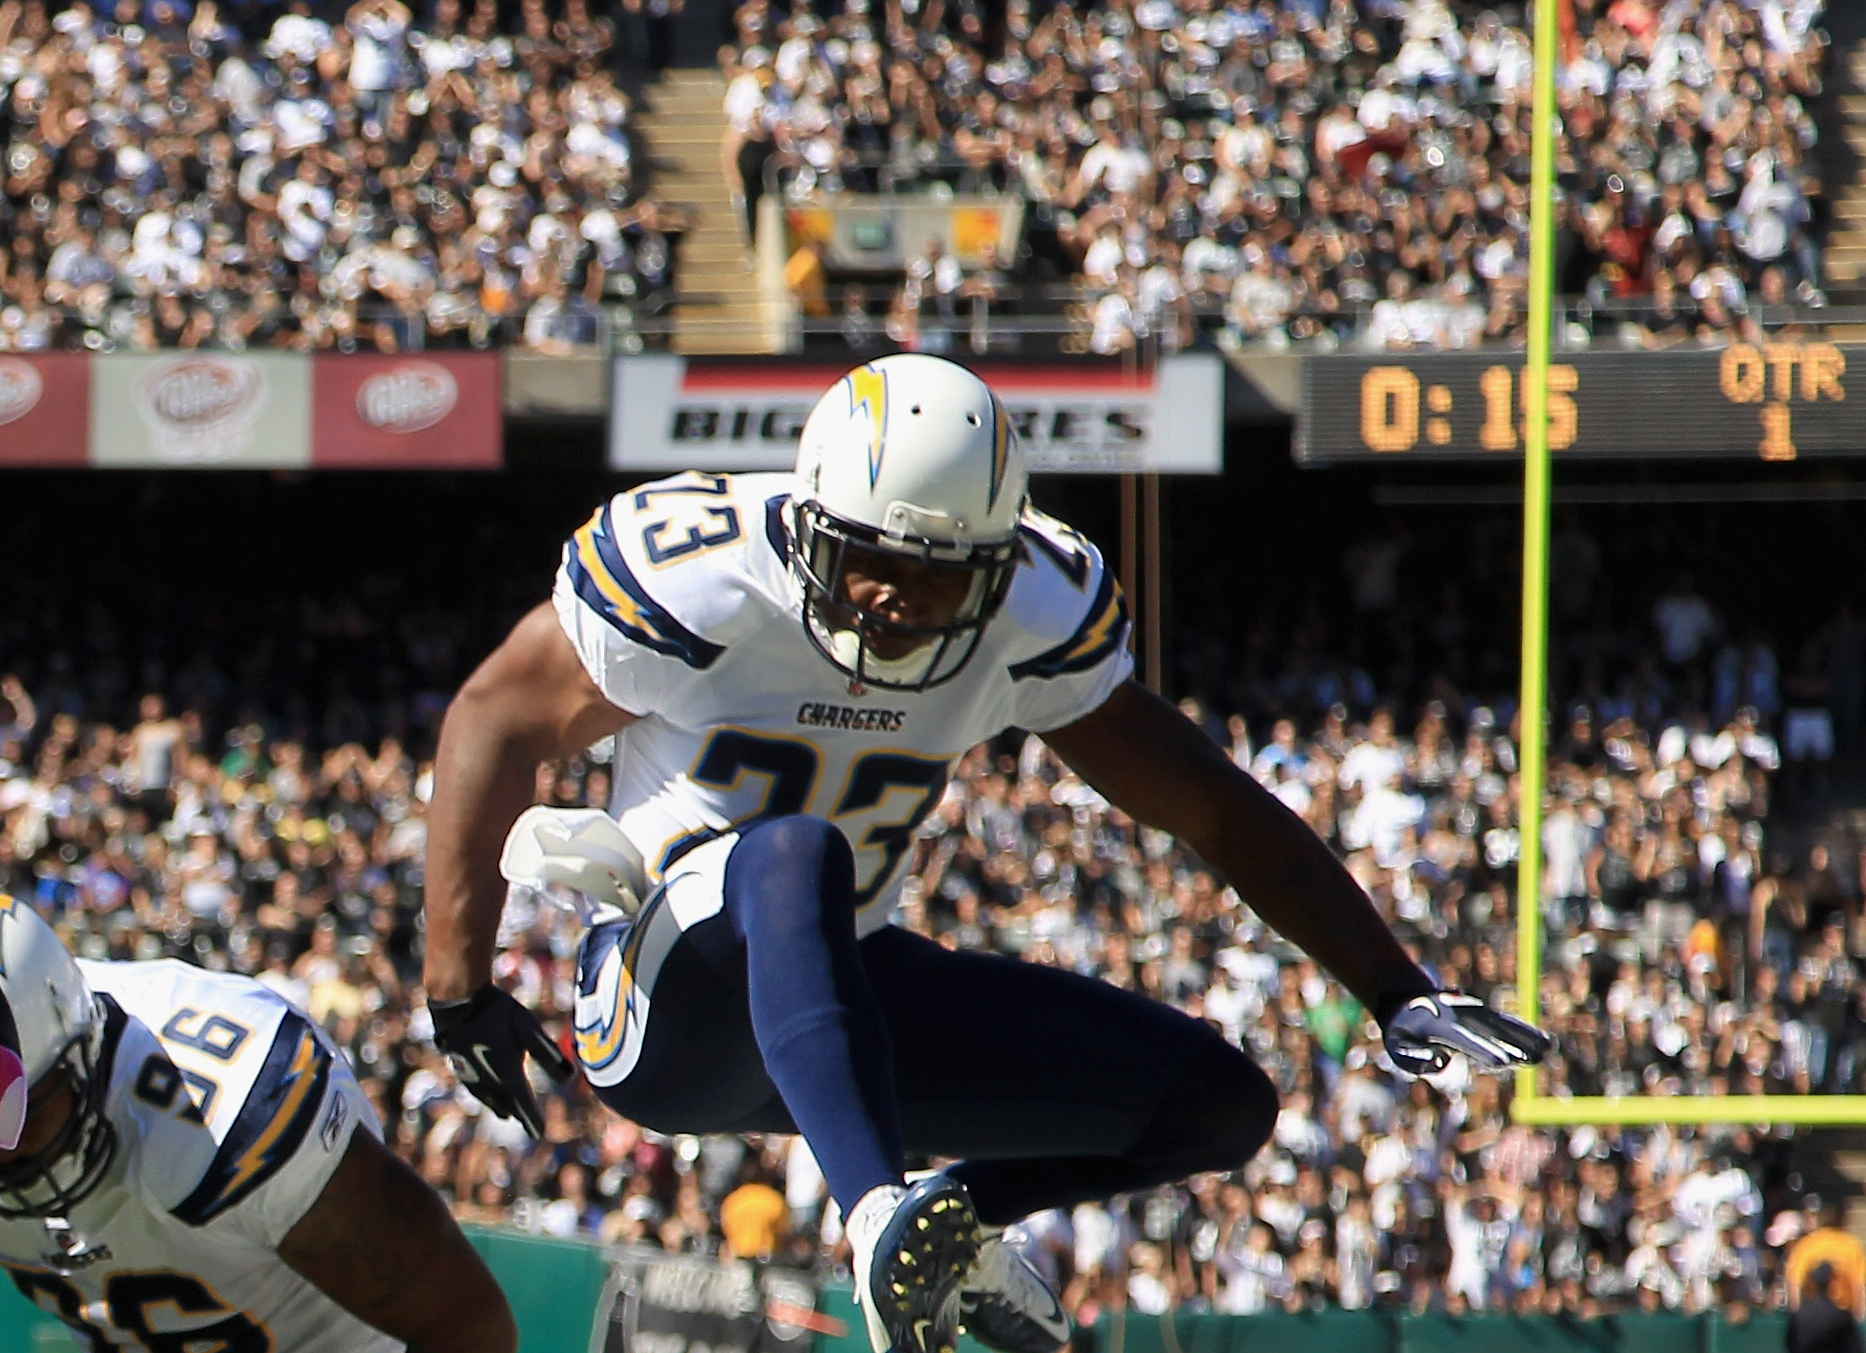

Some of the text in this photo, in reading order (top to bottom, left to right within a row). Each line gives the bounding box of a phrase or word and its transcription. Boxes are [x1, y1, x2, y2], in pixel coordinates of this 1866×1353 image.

[1719, 342, 1846, 404] QTR
[1757, 401, 1798, 461] 1
[797, 702, 907, 732] CHARGERS
